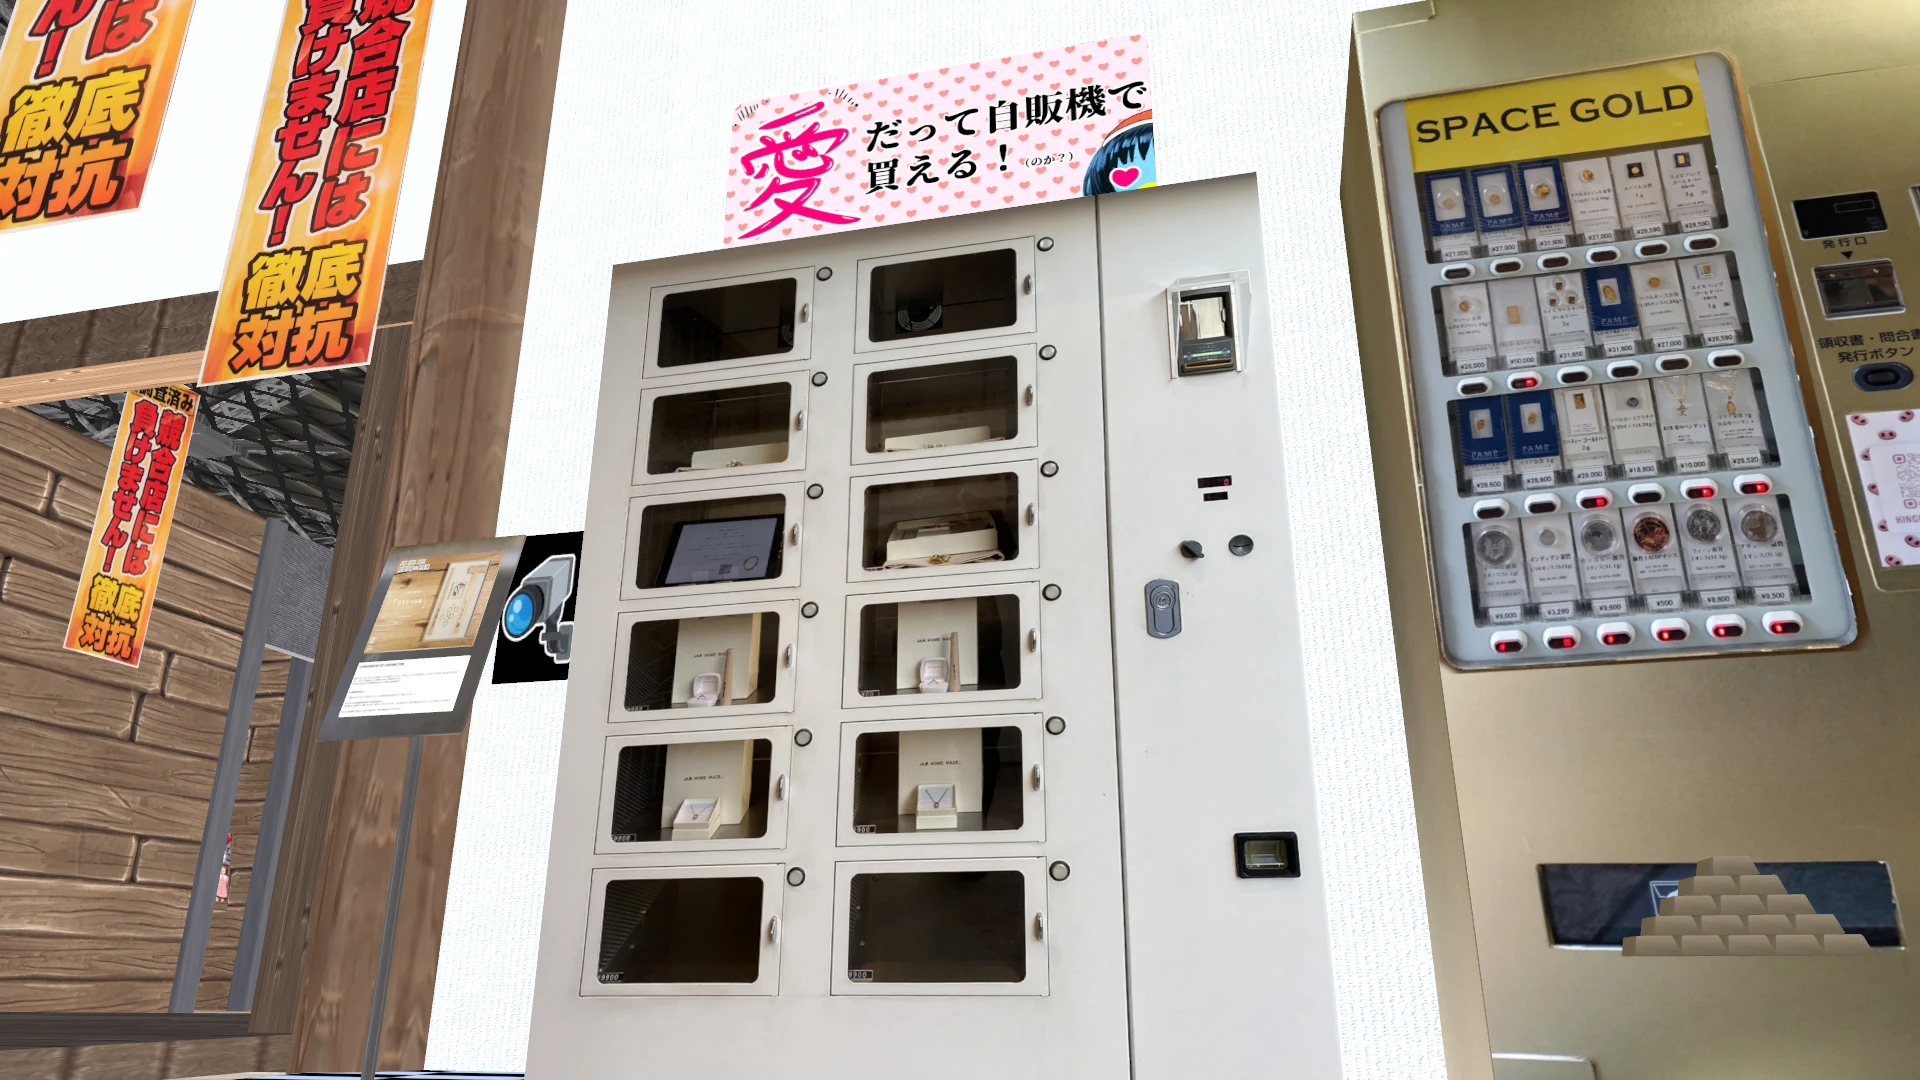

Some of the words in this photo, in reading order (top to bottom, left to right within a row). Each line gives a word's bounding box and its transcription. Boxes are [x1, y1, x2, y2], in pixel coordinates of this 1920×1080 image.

[0, 65, 151, 156] 徹底
[865, 80, 1148, 153] だって自販機で
[1416, 102, 1560, 143] SPACE
[1570, 84, 1694, 125] GOLD
[0, 138, 134, 223] 対抗
[738, 100, 862, 240] 愛
[865, 143, 1008, 195] 買える！
[1487, 218, 1513, 226] PAMP
[1533, 212, 1560, 221] PAMP
[1822, 236, 1867, 249] 発行口
[241, 239, 368, 314] 徹底
[228, 302, 358, 374] 対抗
[1601, 316, 1628, 324] PAMP
[1838, 347, 1914, 363] 発行ボタン
[1471, 450, 1498, 459] PAMP
[1522, 444, 1550, 453] PAMP
[1680, 460, 1706, 468] ¥10,000
[101, 398, 159, 573] 負けません！
[121, 408, 187, 575] 競合店には
[1895, 515, 1920, 524] KINC
[87, 573, 145, 624] 徹底
[79, 611, 137, 661] 対抗
